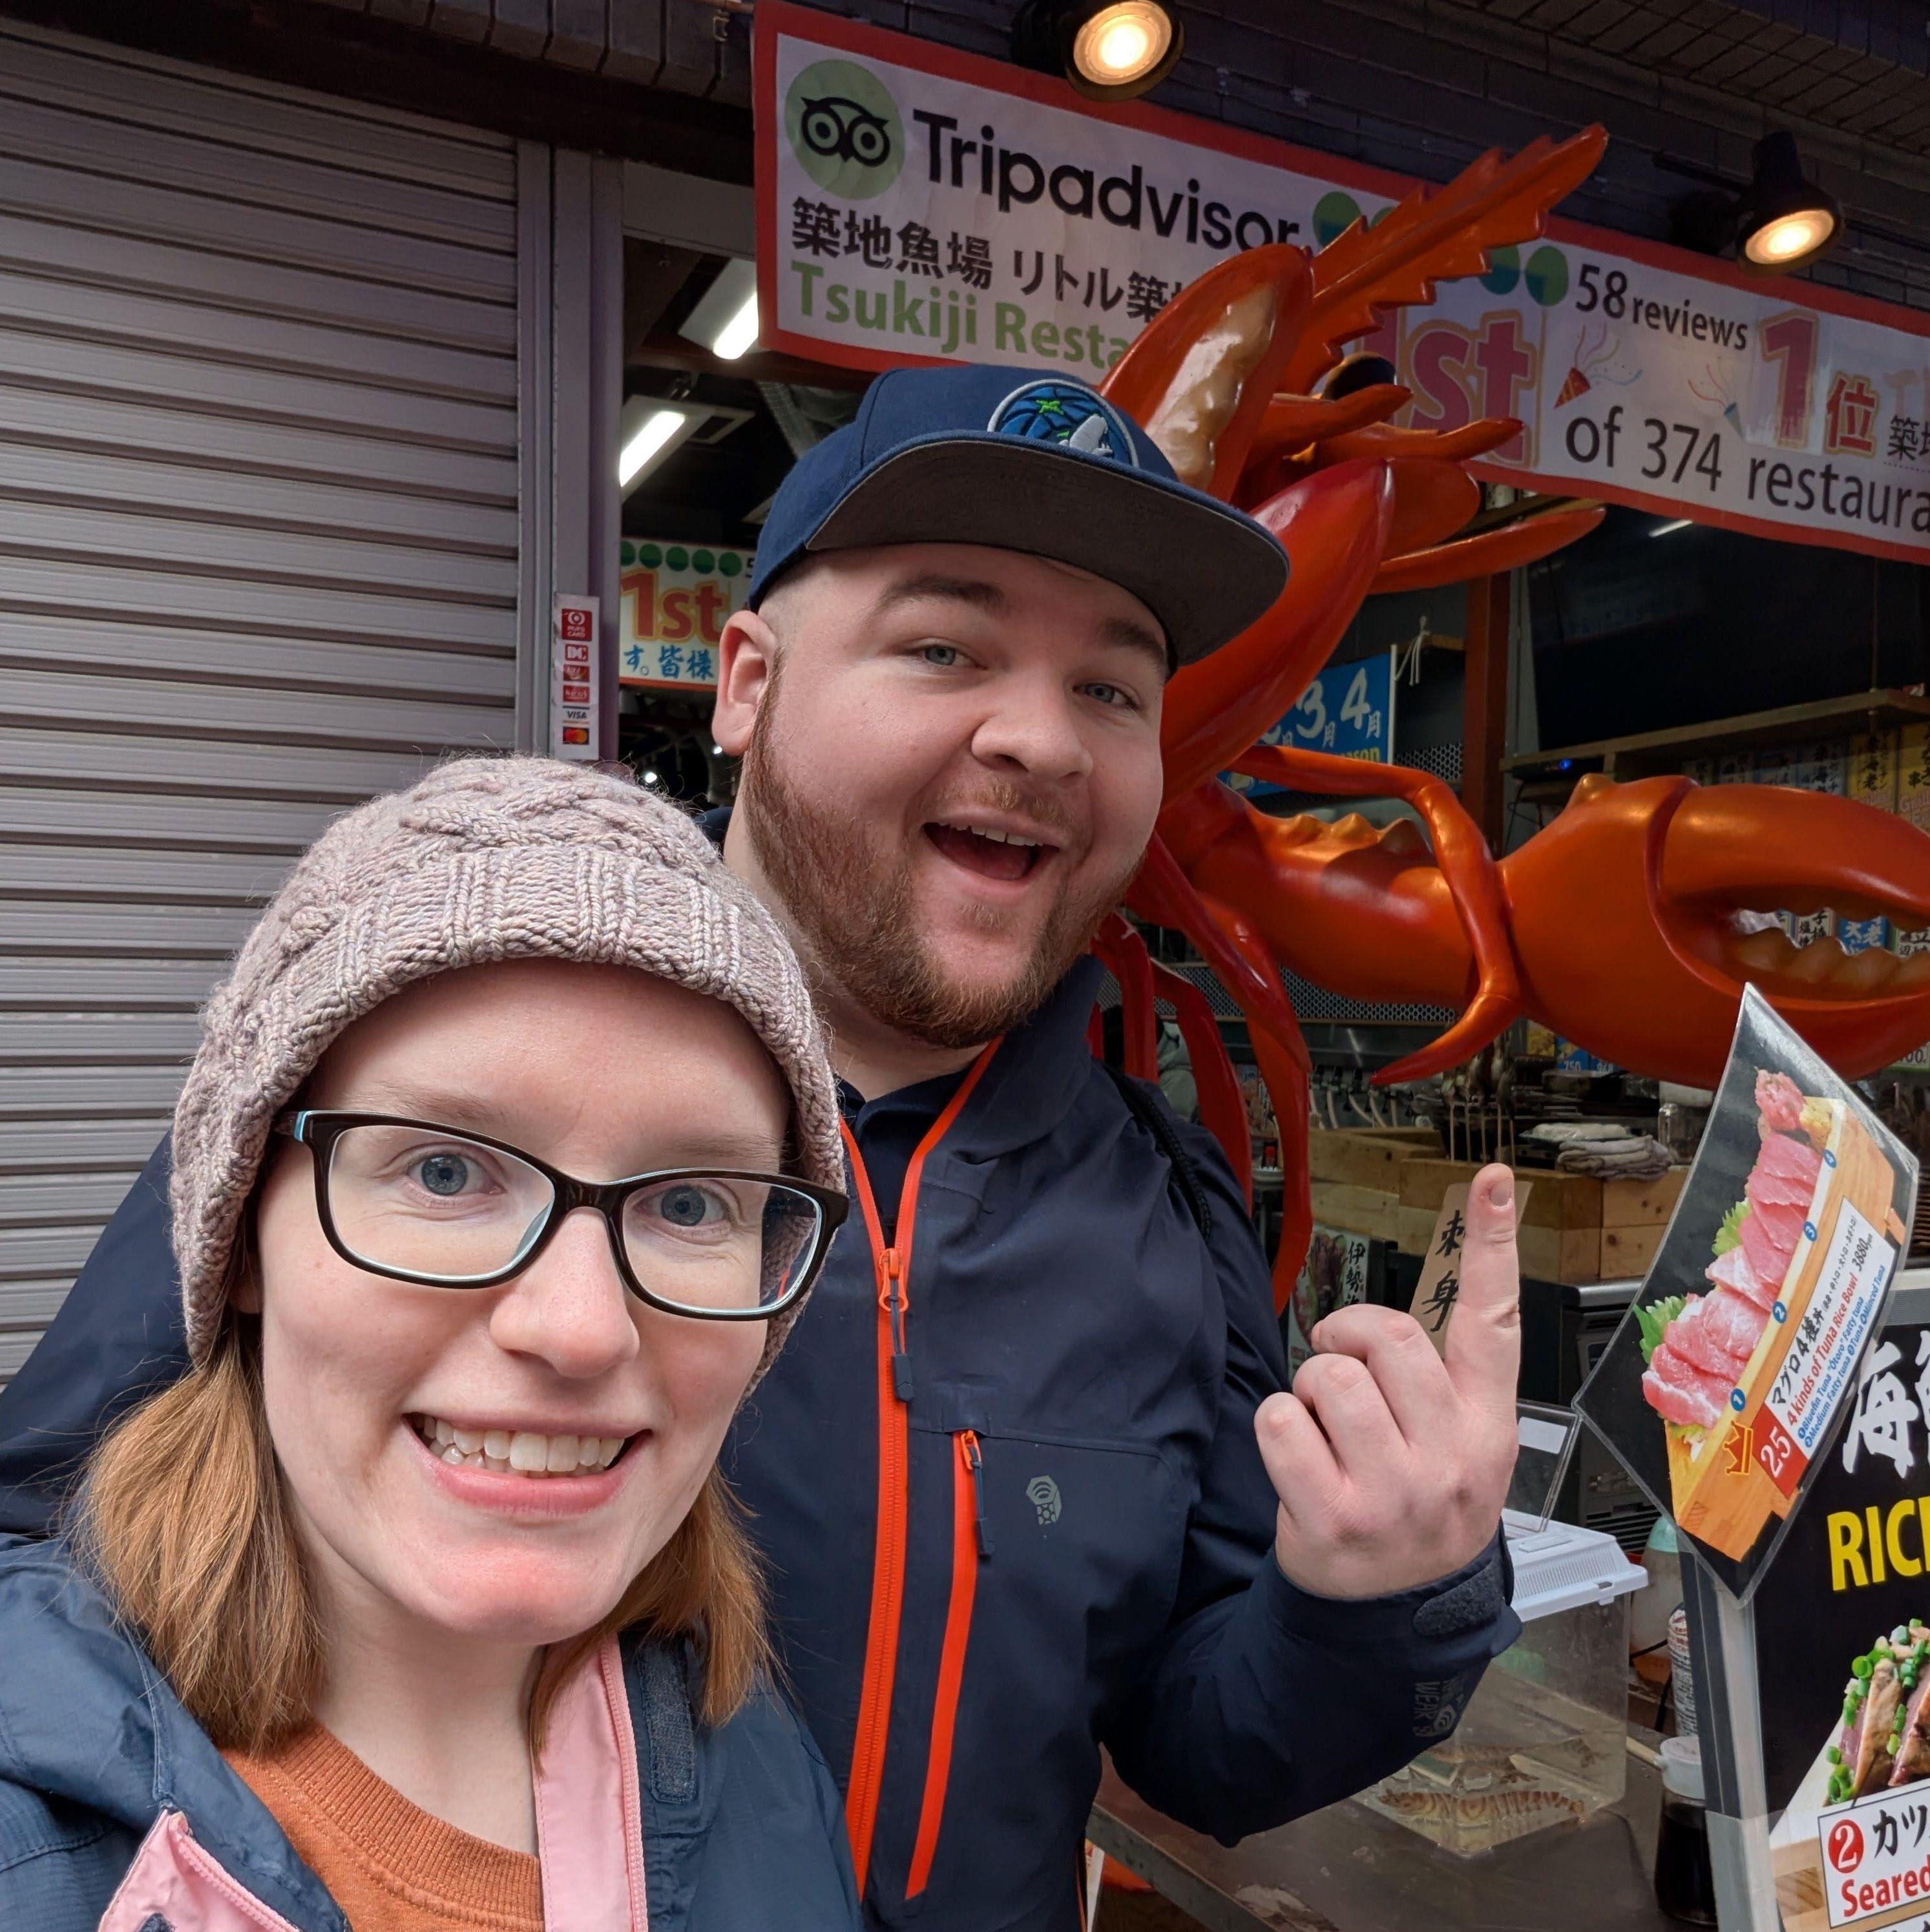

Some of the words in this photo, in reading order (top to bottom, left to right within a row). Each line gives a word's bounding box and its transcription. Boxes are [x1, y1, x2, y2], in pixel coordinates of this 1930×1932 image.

[912, 109, 1299, 250] Tripadvisor
[792, 196, 993, 291] 築地魚場
[1013, 249, 1182, 323] リトル築
[791, 261, 977, 353] Tsukiji
[1575, 264, 1628, 320] 58
[1632, 299, 1748, 352] reviews
[1566, 406, 1622, 468] of
[1641, 417, 1722, 492] 374
[622, 571, 722, 643] 1st
[1832, 1303, 1847, 1328] Rice
[1841, 1272, 1858, 1305] Bowl
[1811, 1354, 1822, 1378] of
[1816, 1326, 1838, 1361] Tuna
[1817, 1373, 1832, 1397] Tuna
[1842, 1317, 1856, 1340] Fatty
[1852, 1296, 1864, 1318] tuna
[1827, 1378, 1842, 1402] Fatty
[1838, 1356, 1851, 1379] tuna
[1874, 1265, 1886, 1286] Tuna
[1787, 1410, 1798, 1426] 4
[1790, 1375, 1815, 1416] kinds
[1843, 1330, 1930, 1480] 海
[1759, 1425, 1791, 1480] 25
[1841, 1854, 1930, 1918] Seared
